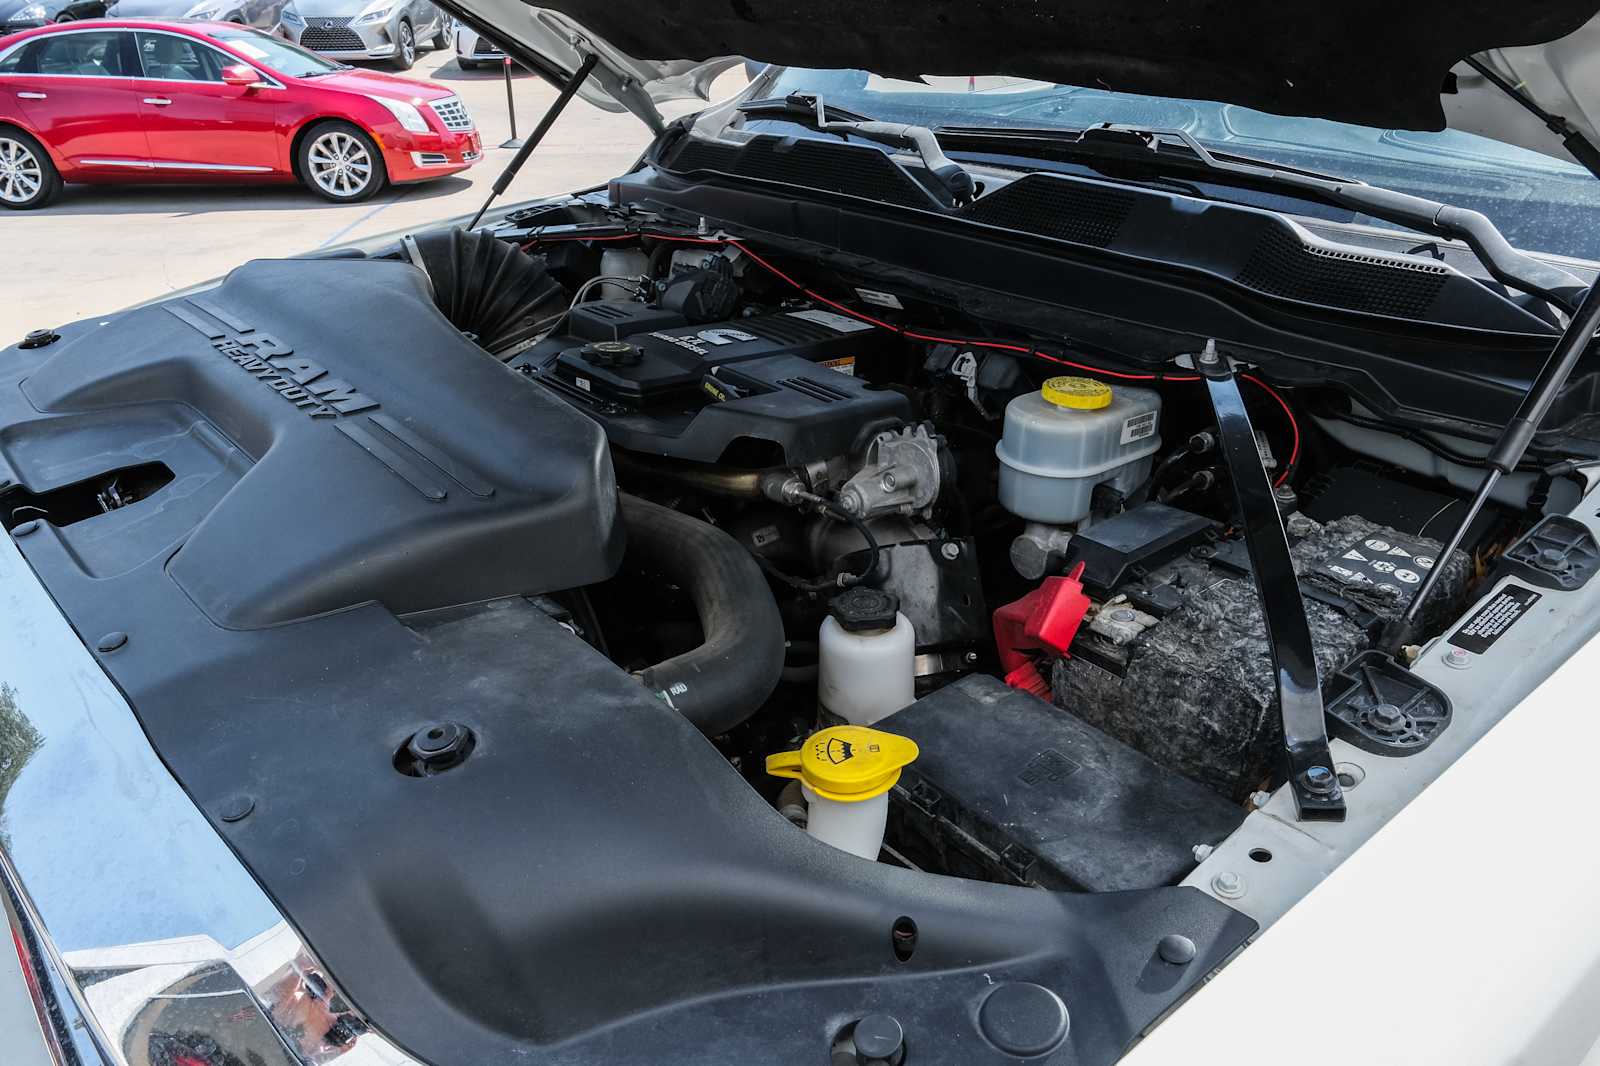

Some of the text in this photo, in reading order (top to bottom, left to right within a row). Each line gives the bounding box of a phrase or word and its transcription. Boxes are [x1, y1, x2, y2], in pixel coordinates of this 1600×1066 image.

[211, 339, 337, 419] HEAVY DUTY
[233, 332, 381, 415] RAM
[669, 681, 688, 696] RAD
